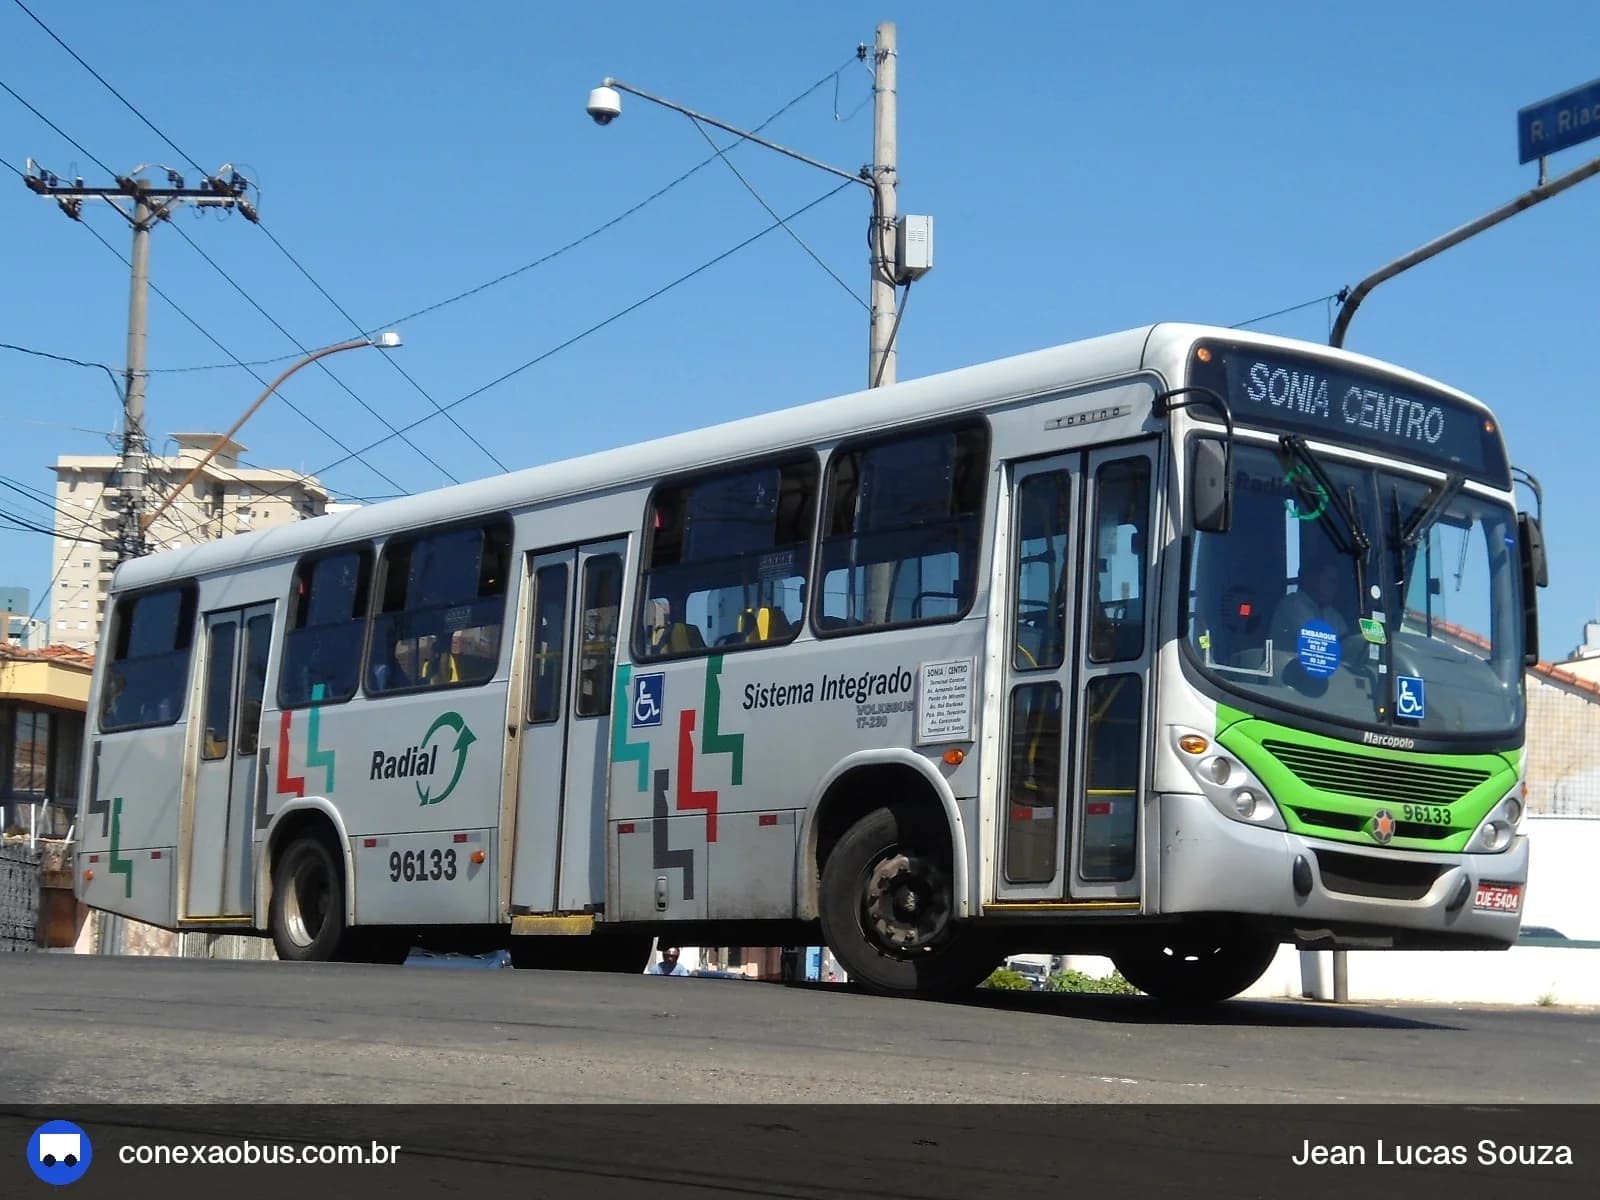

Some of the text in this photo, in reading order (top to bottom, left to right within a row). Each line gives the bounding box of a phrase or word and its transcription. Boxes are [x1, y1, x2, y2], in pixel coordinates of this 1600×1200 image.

[1247, 362, 1444, 444] SONIA CENTRO
[1301, 628, 1337, 641] EMBARQUE
[927, 668, 943, 678] SONIA
[948, 665, 968, 674] CENTRO
[742, 665, 912, 710] Sistema Integrado
[1363, 731, 1415, 749] Marcopolo
[369, 744, 438, 781] Radial
[1403, 804, 1452, 825] 96133
[389, 848, 457, 882] 96133
[1475, 891, 1518, 909] CUE-5404
